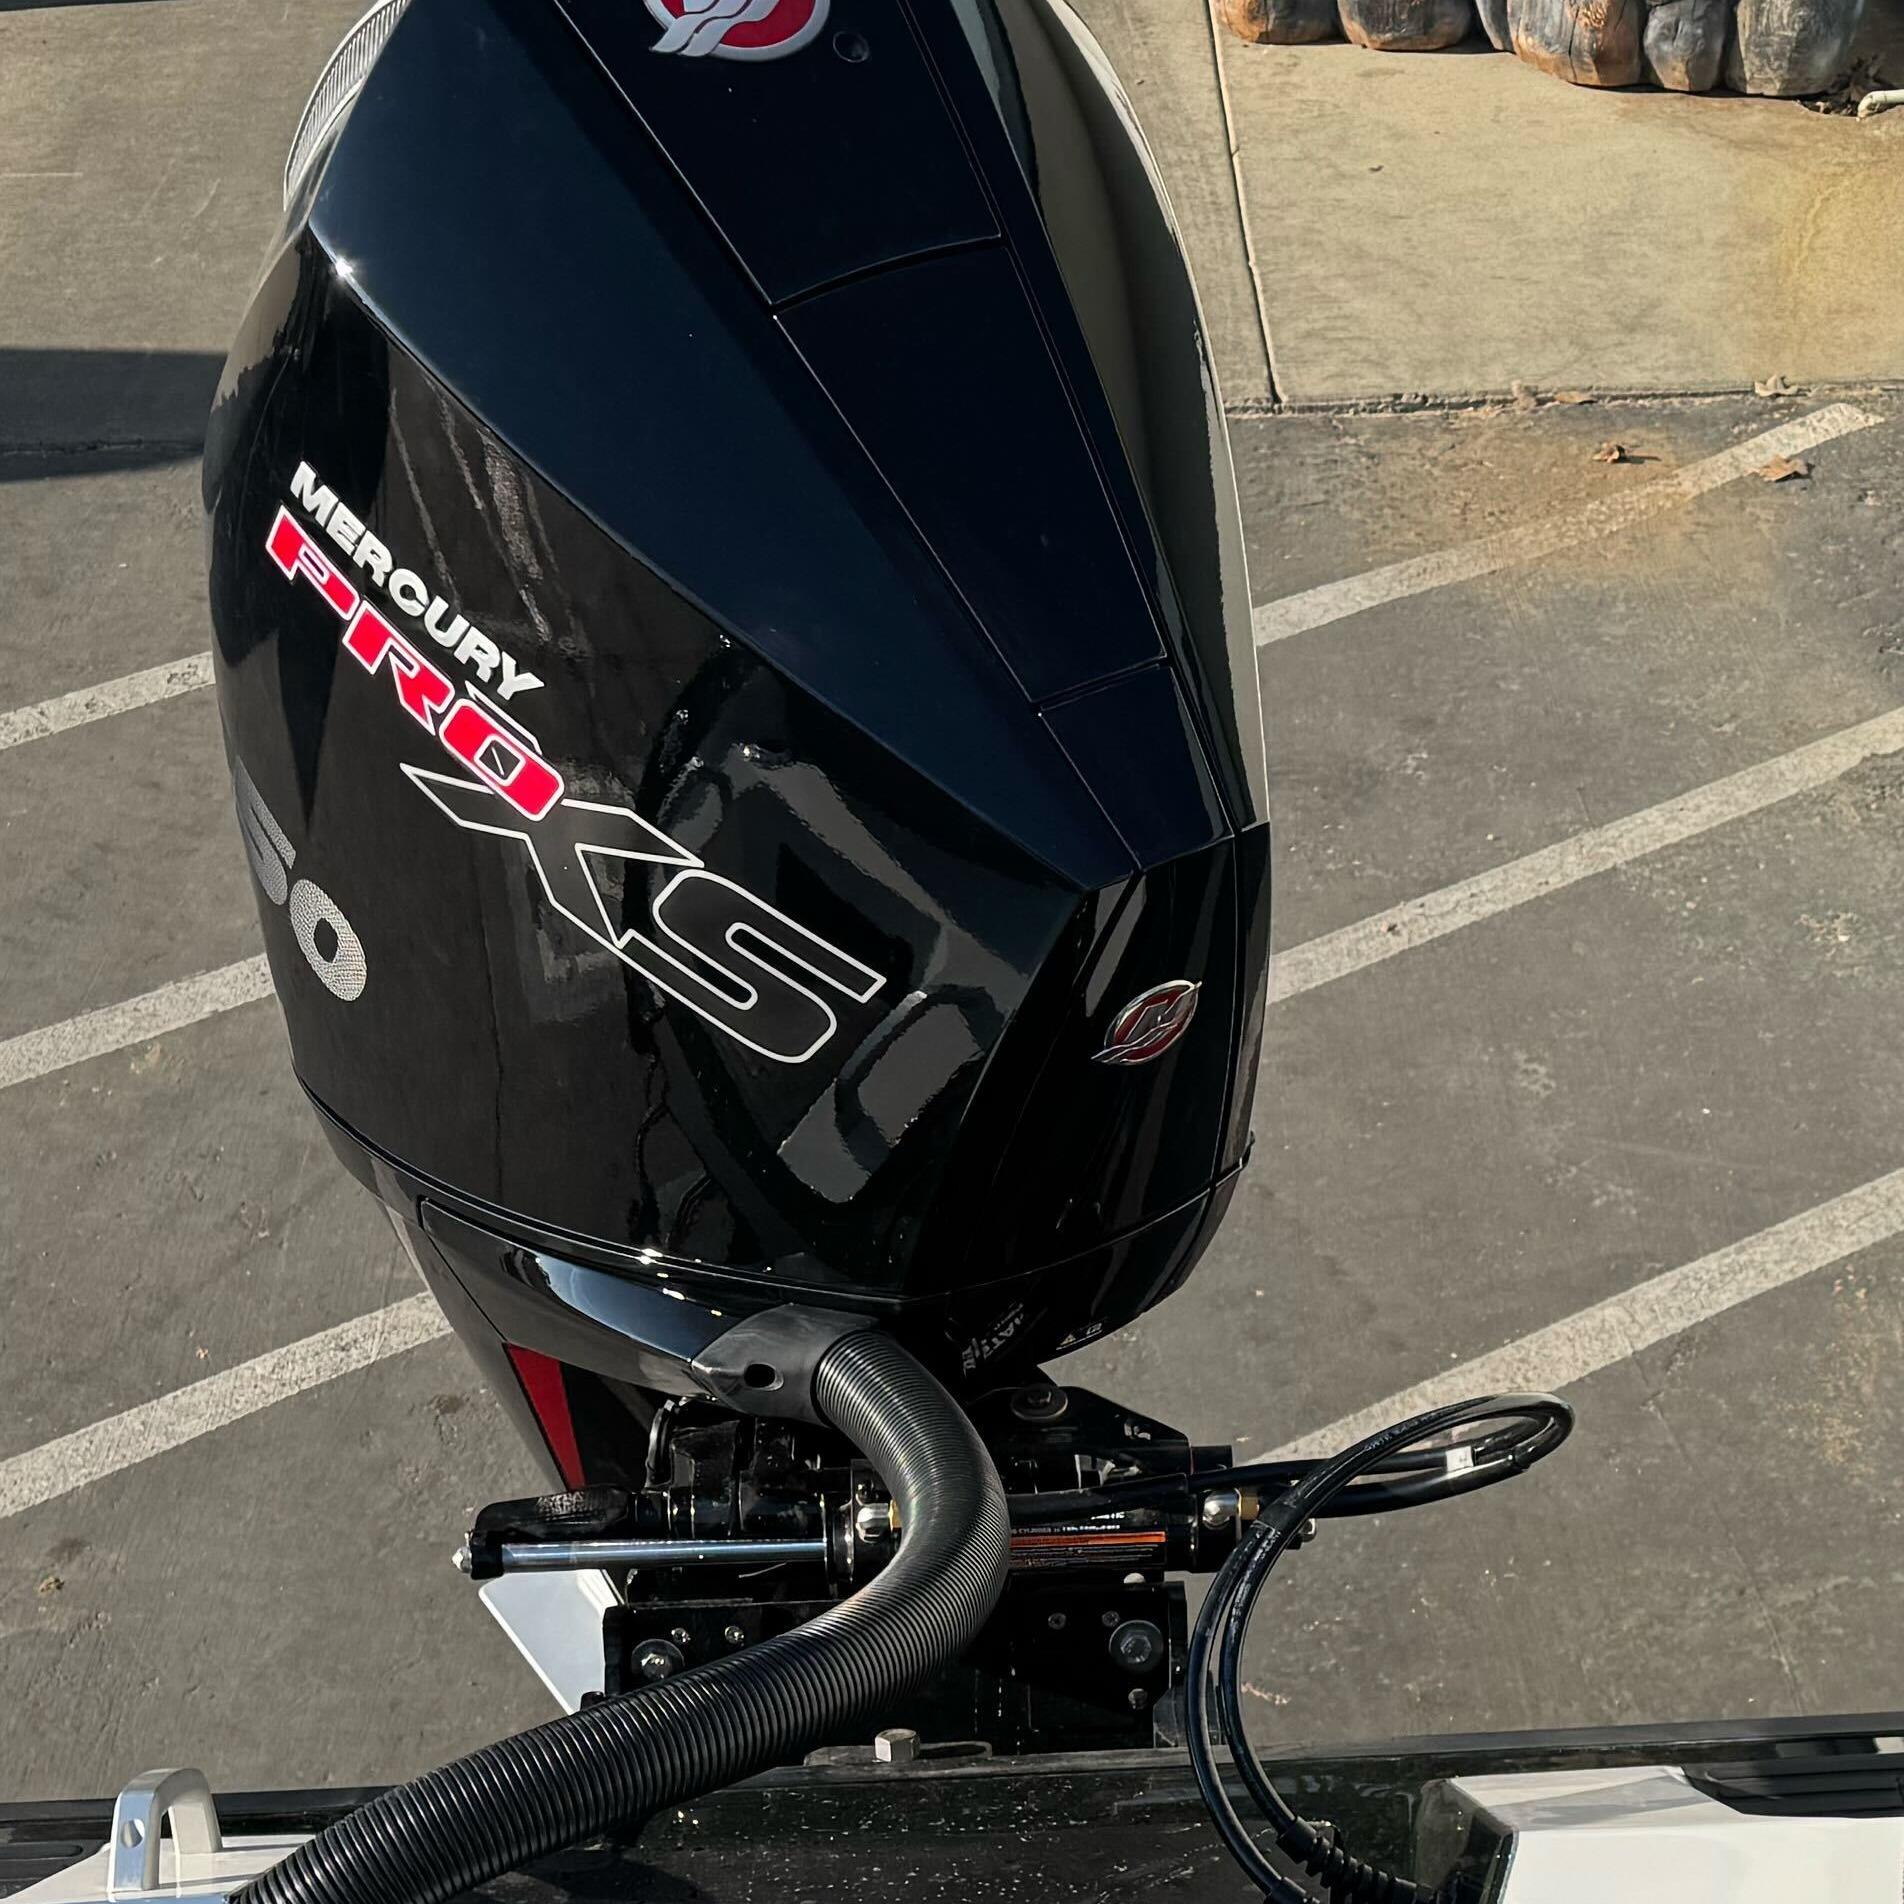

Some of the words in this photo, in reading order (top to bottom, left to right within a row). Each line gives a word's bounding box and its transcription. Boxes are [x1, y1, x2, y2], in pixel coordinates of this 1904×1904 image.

[265, 504, 565, 821] PRO
[290, 461, 544, 701] MERCURY
[399, 680, 888, 1063] XS
